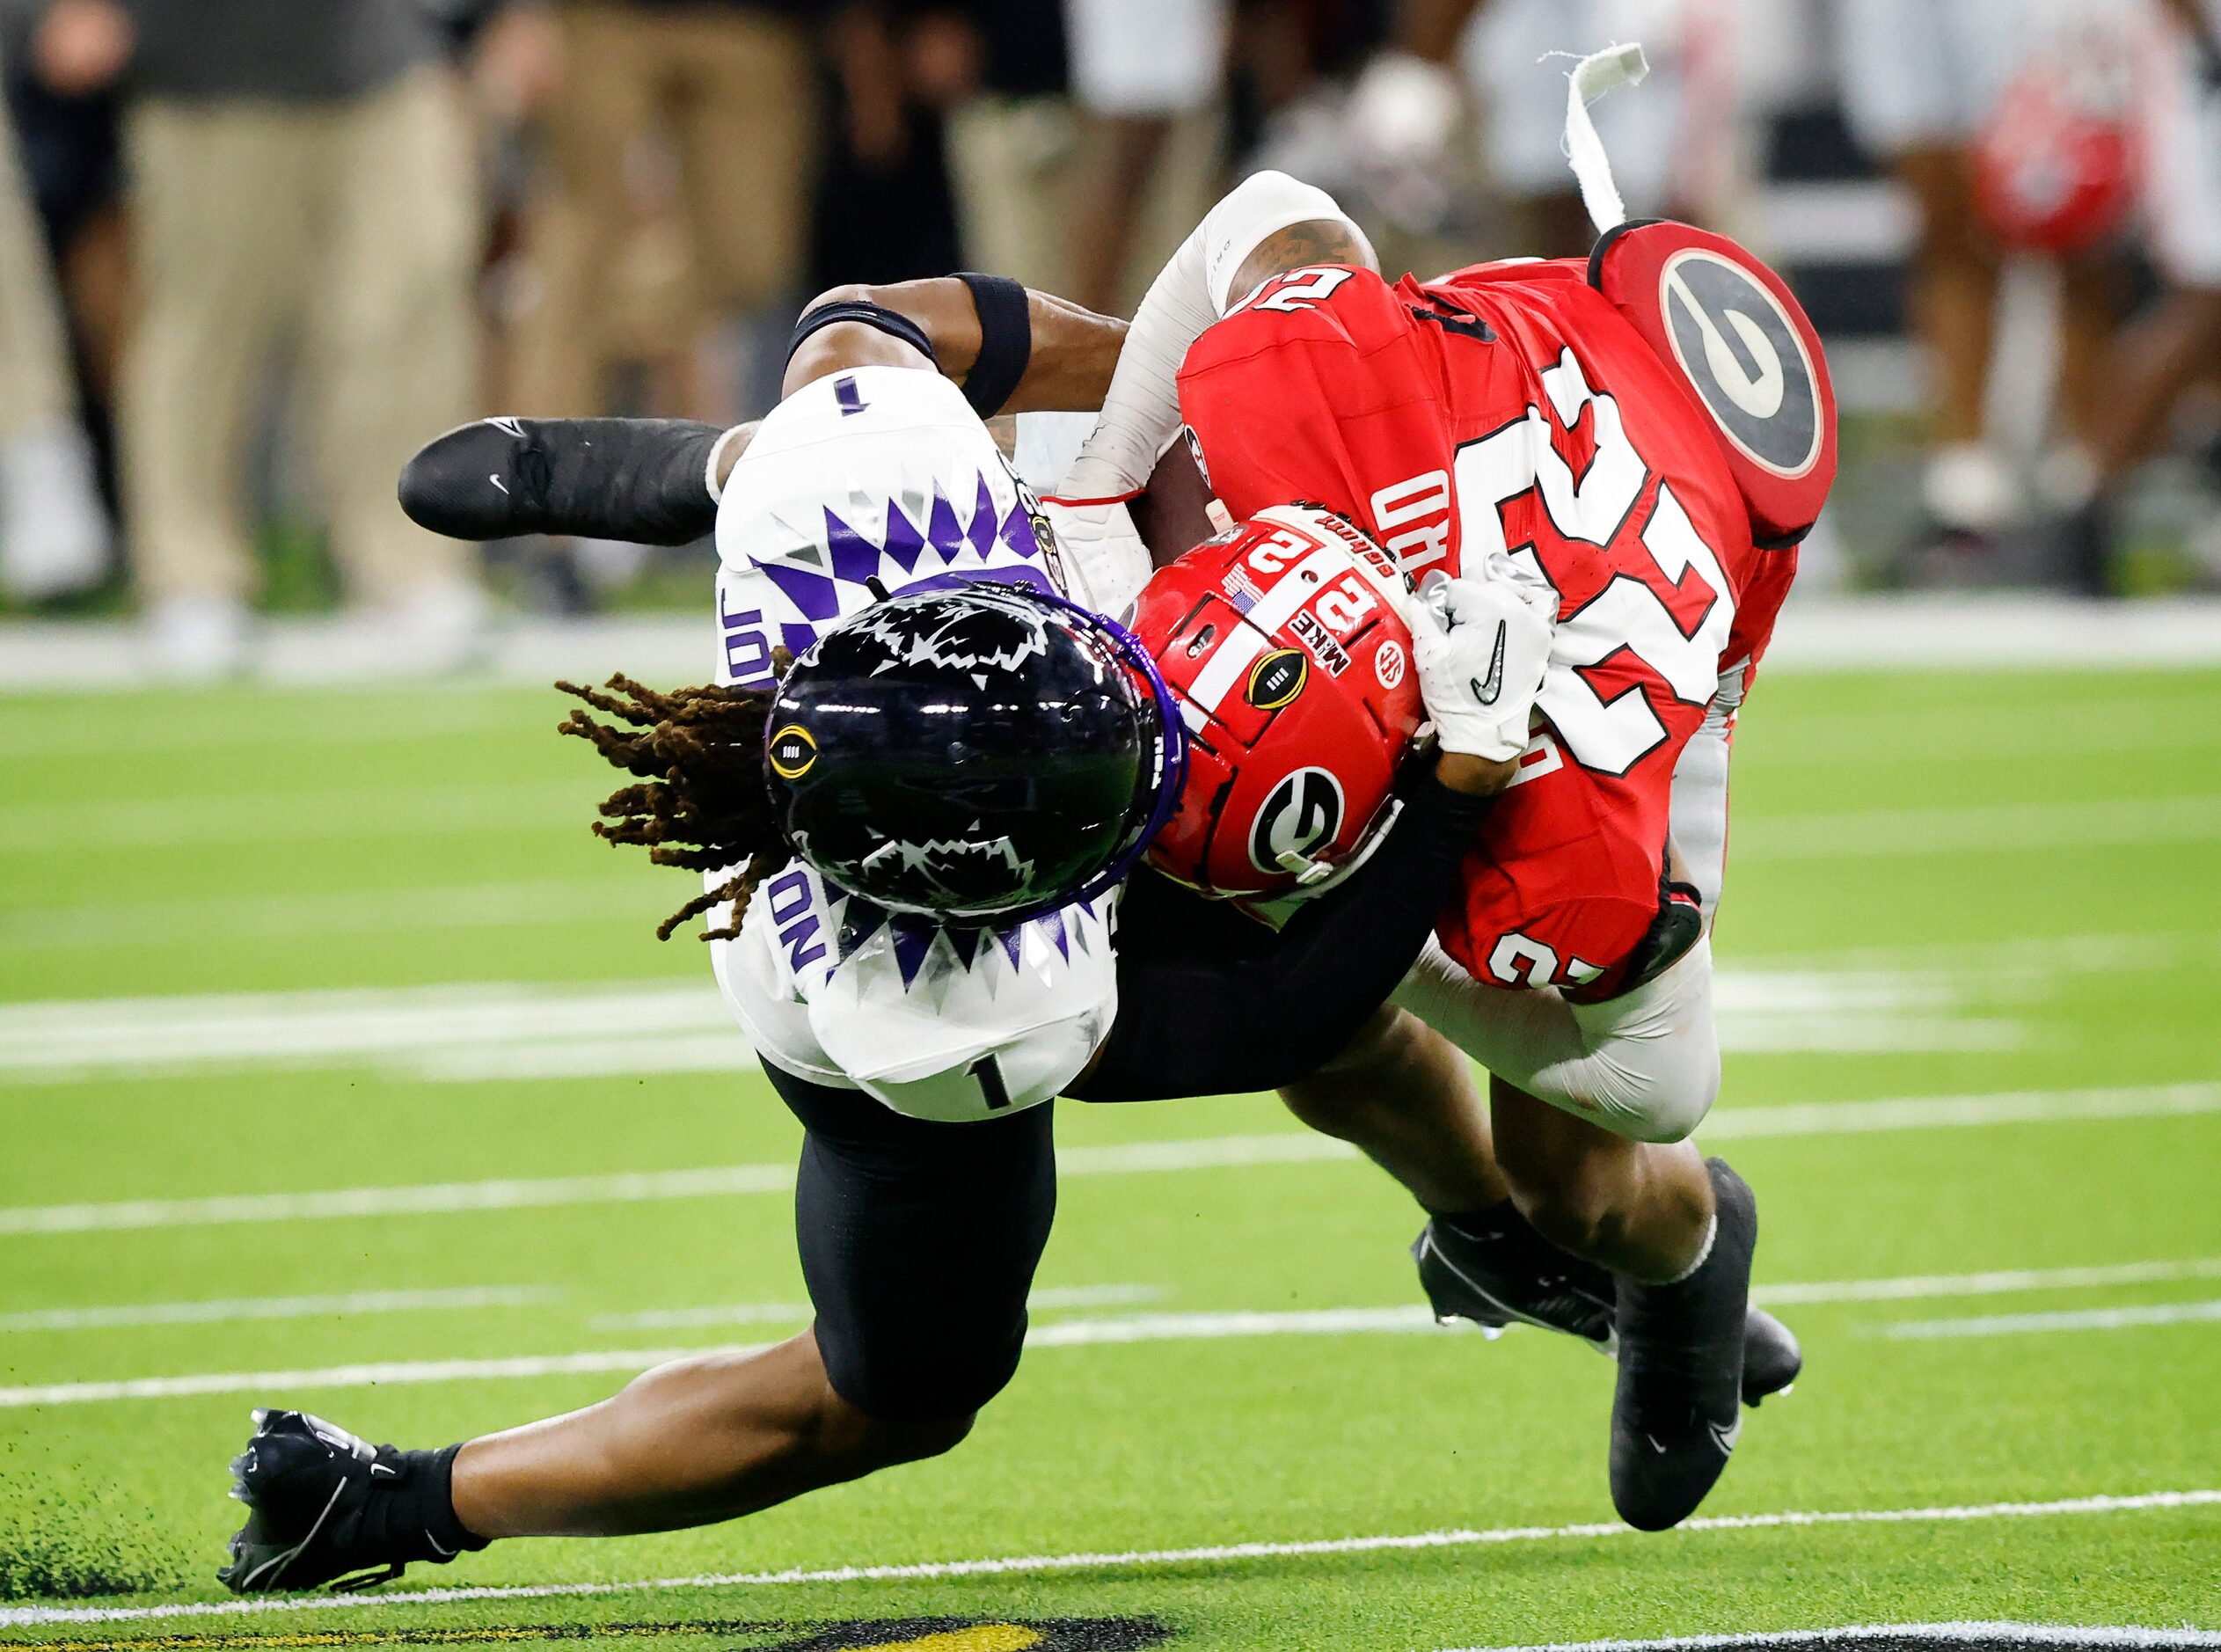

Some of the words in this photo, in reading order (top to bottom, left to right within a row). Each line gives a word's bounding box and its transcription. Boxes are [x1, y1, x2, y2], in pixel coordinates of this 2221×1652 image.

[833, 376, 871, 416] 1
[1454, 345, 1736, 777] 22
[1291, 612, 1349, 676] MIKE
[1376, 648, 1405, 684] SEC
[964, 1052, 1013, 1111] 1
